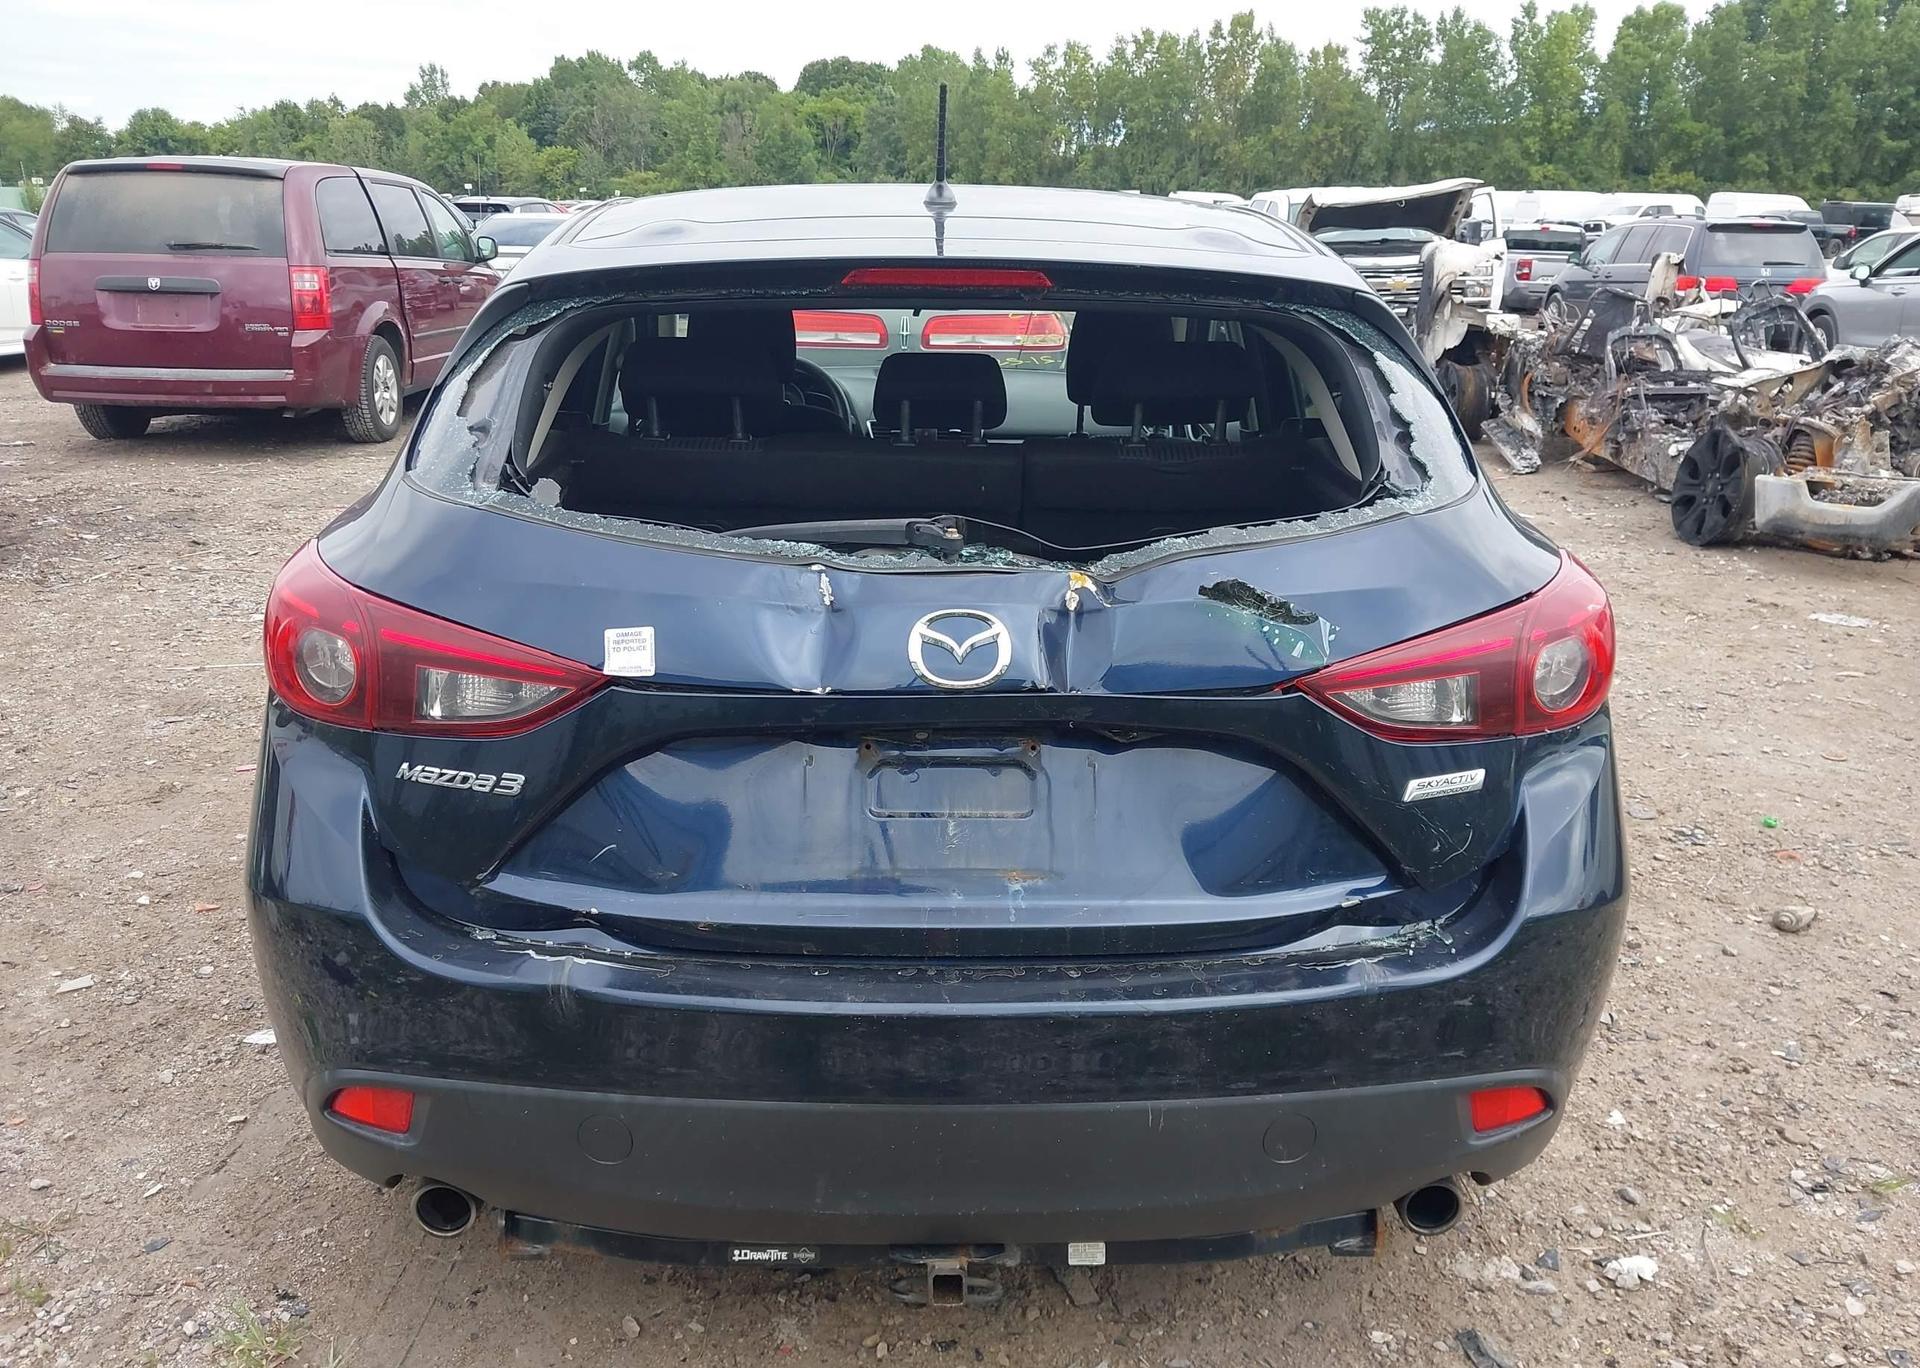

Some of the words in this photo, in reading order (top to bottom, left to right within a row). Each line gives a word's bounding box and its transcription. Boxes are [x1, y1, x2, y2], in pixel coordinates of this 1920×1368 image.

[45, 319, 80, 327] DODGE
[612, 638, 647, 646] REPORTED
[1416, 772, 1479, 791] SKYACTIV
